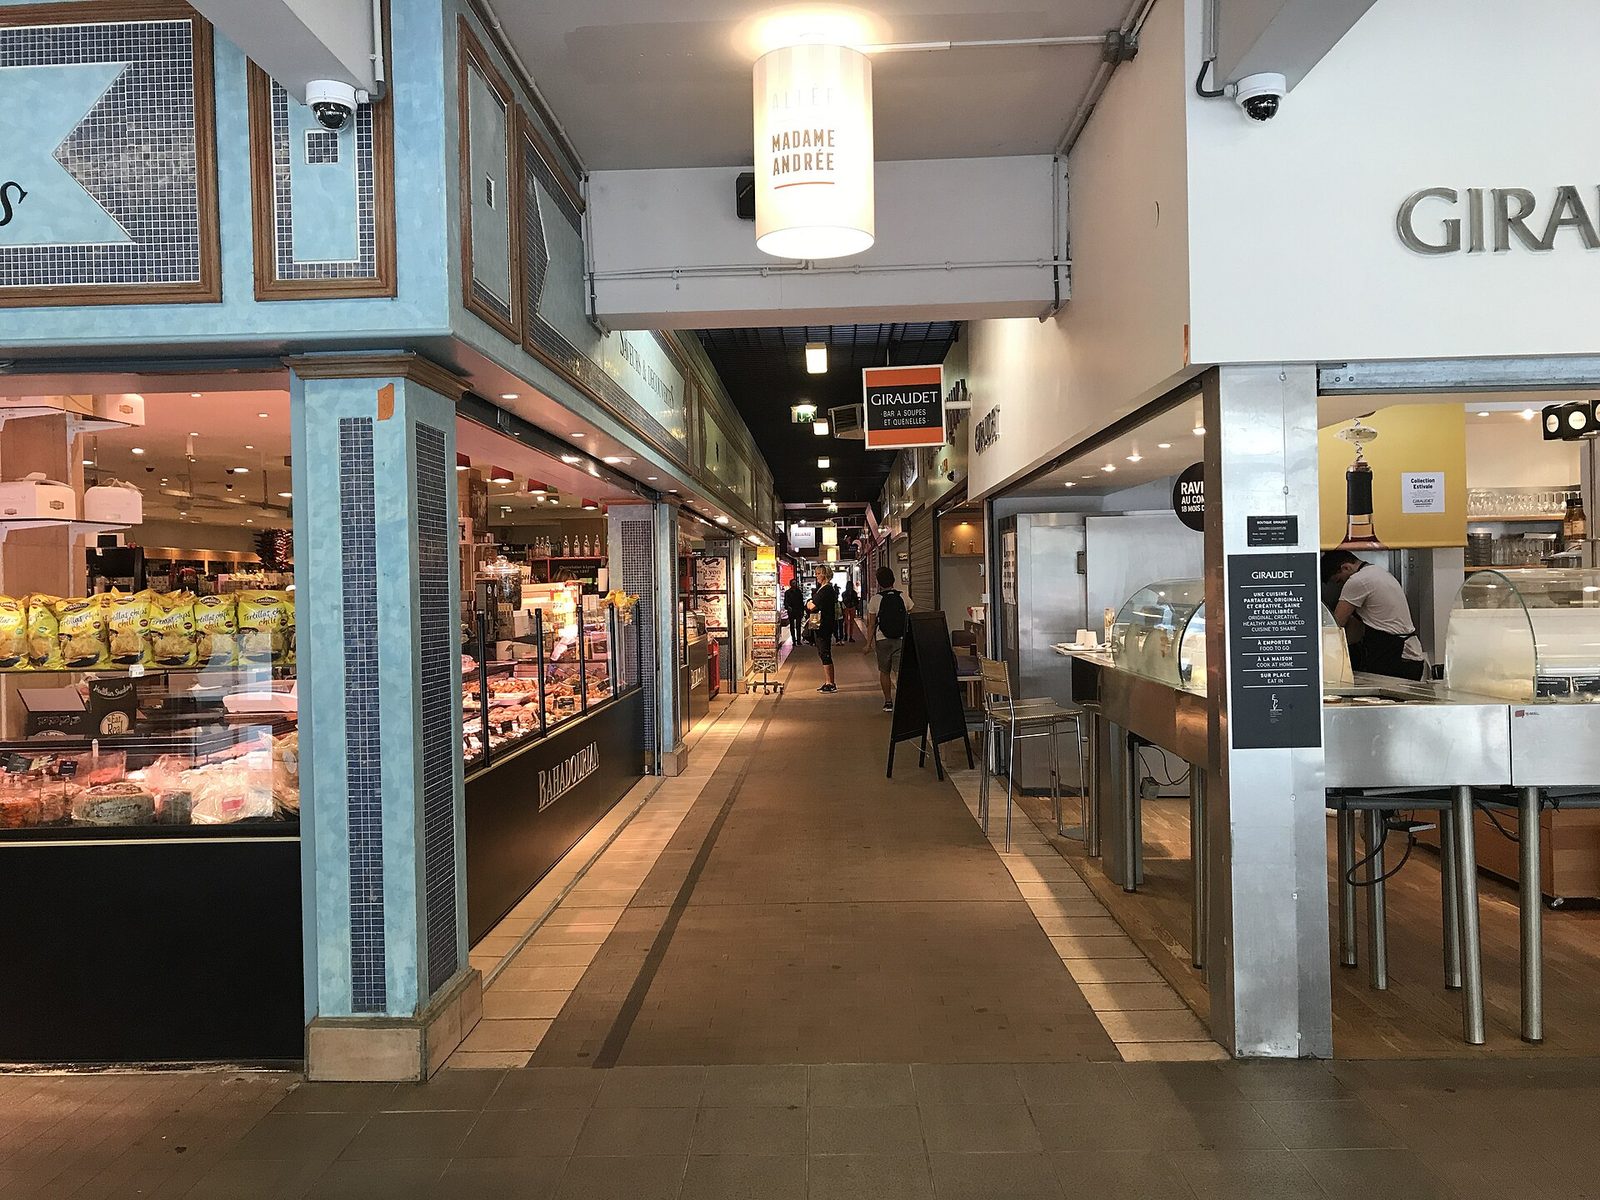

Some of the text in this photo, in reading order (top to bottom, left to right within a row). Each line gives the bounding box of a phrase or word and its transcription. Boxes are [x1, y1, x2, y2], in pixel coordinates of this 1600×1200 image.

[772, 129, 836, 152] MADAME
[773, 149, 835, 176] ANDRÉE
[1396, 185, 1600, 256] GIRA
[870, 391, 938, 406] GIRAUDET
[903, 408, 927, 416] SOUPES
[893, 417, 927, 426] QUENELLES
[1181, 481, 1204, 495] RAVI
[1181, 495, 1191, 505] AU
[1251, 570, 1294, 580] GIRAUDET
[537, 741, 600, 809] BAHADOURIAN
